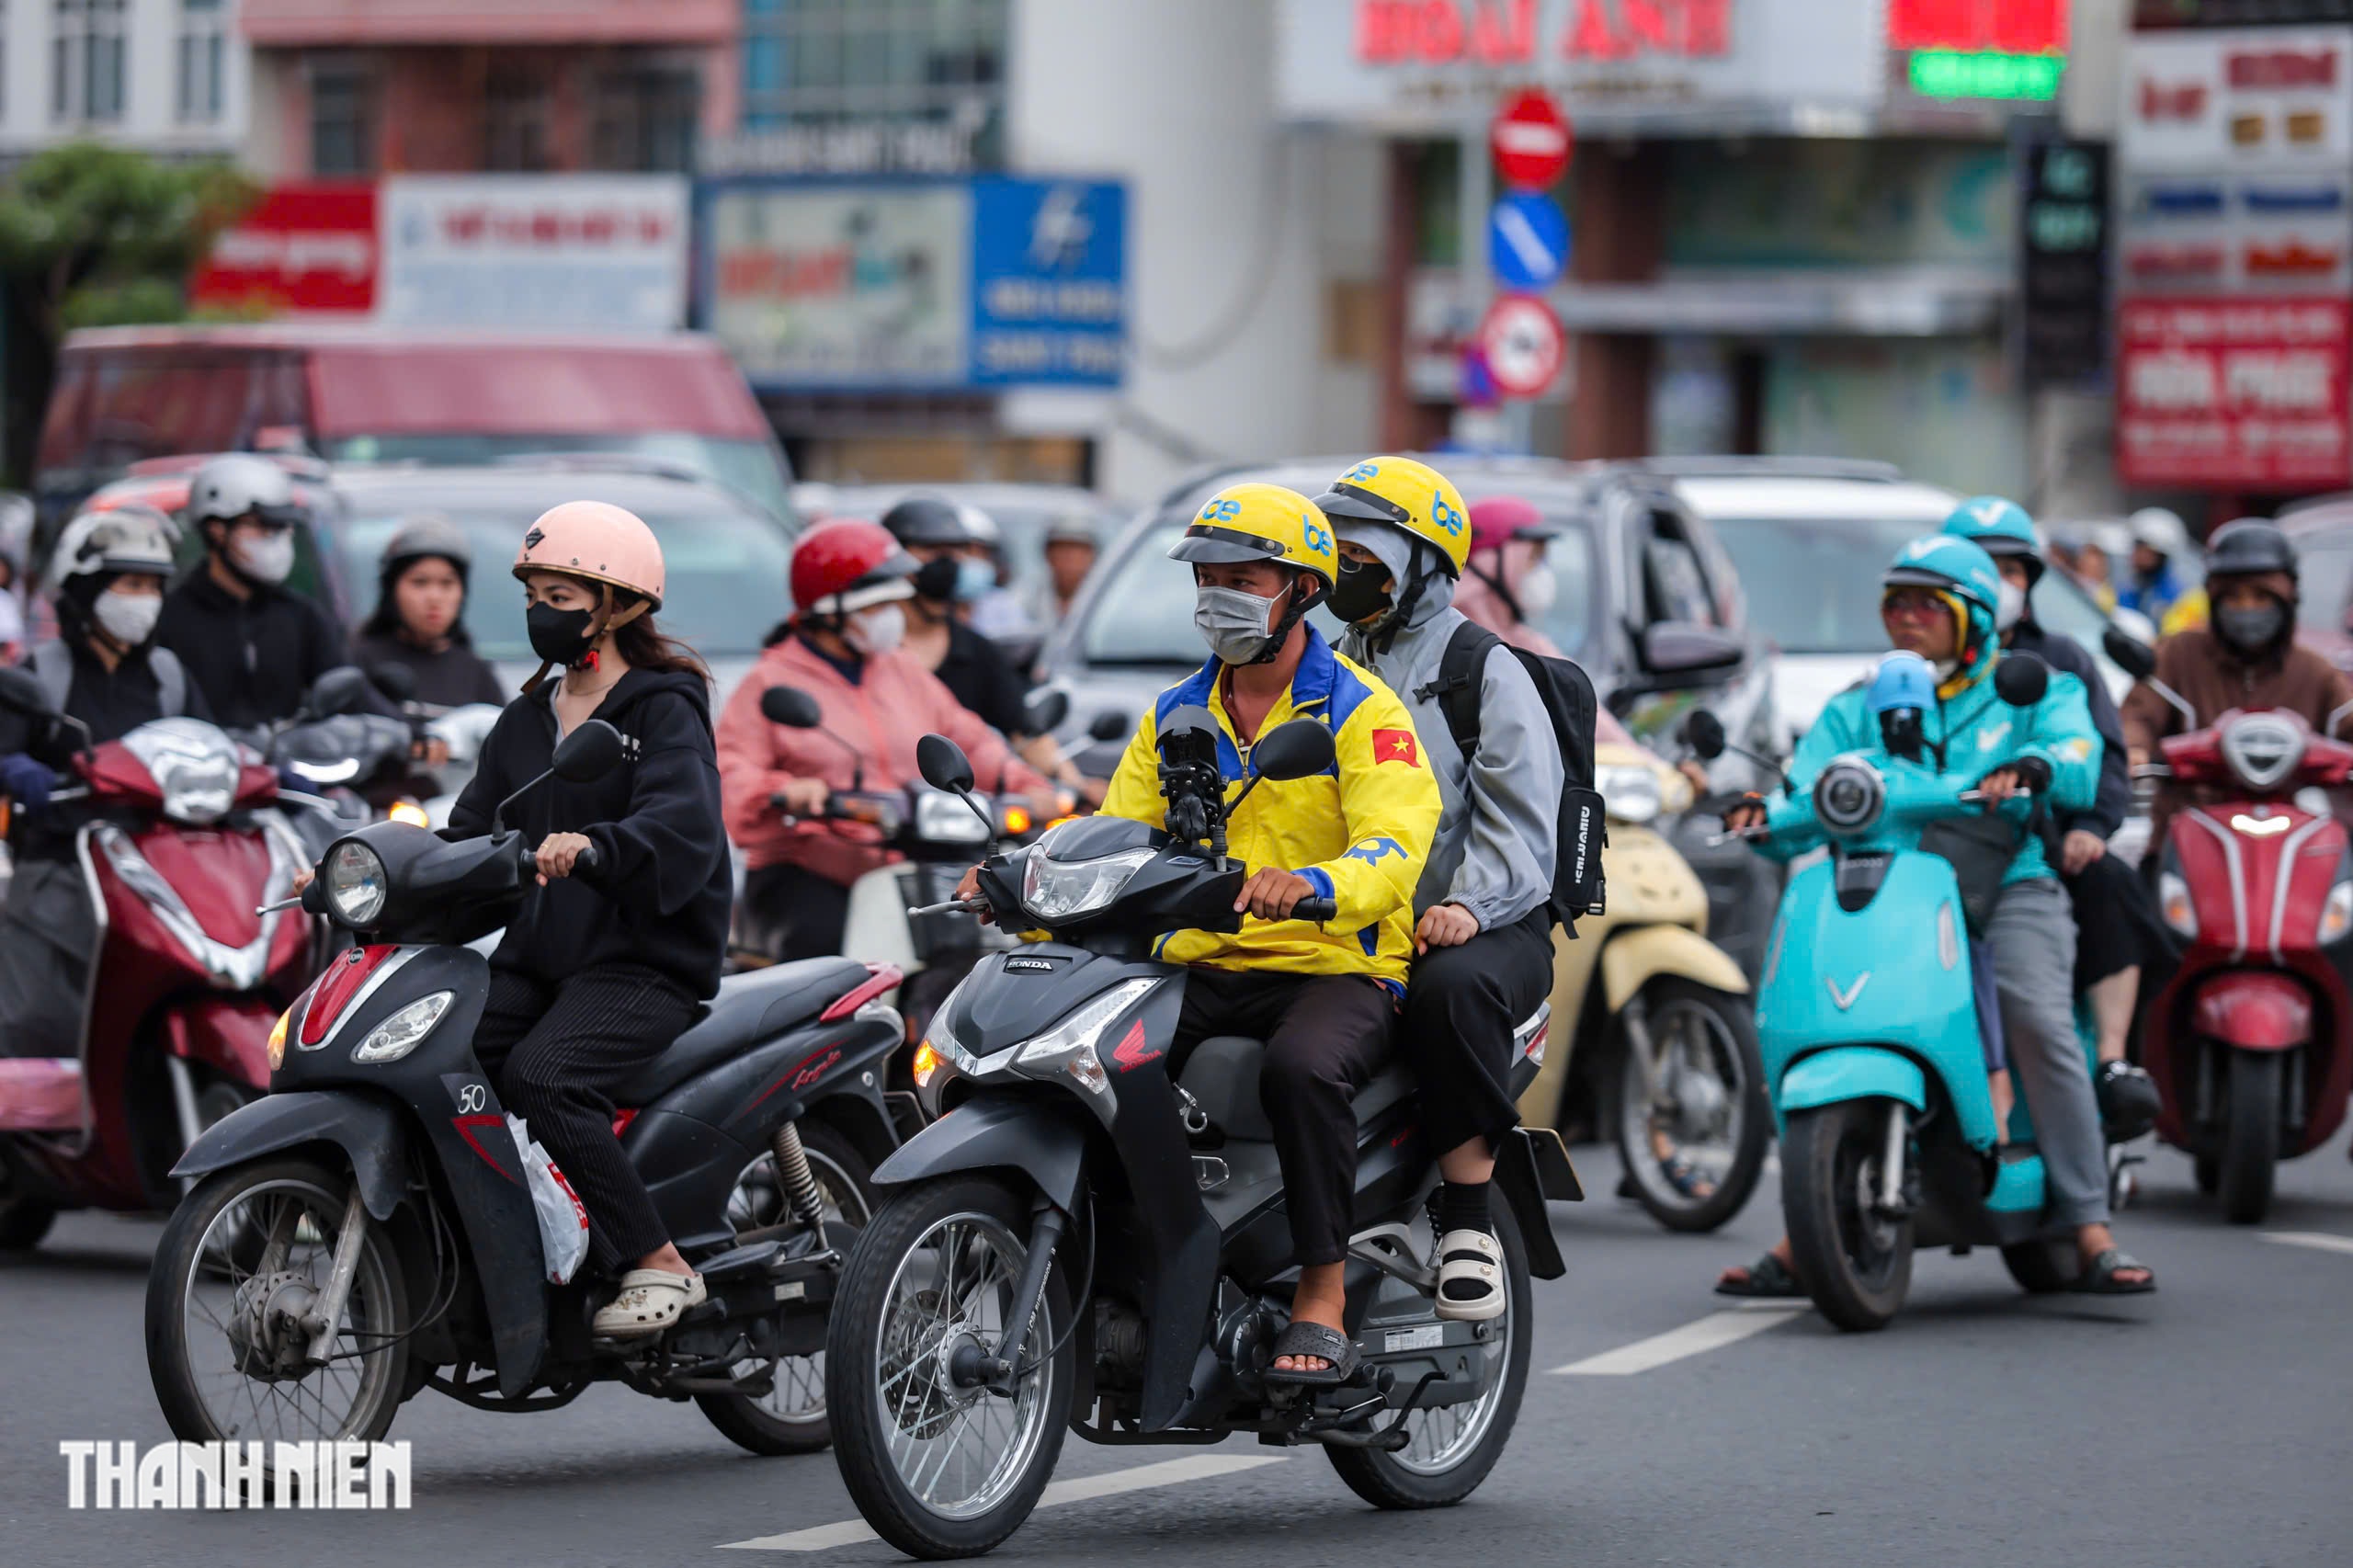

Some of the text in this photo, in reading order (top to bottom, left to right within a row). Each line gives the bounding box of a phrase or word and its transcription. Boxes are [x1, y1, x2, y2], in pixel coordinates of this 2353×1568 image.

[1431, 490, 1463, 537] be
[1302, 514, 1332, 556] be
[1007, 960, 1053, 970] HONDA
[1119, 1049, 1163, 1074] HONDA
[458, 1084, 486, 1115] 50
